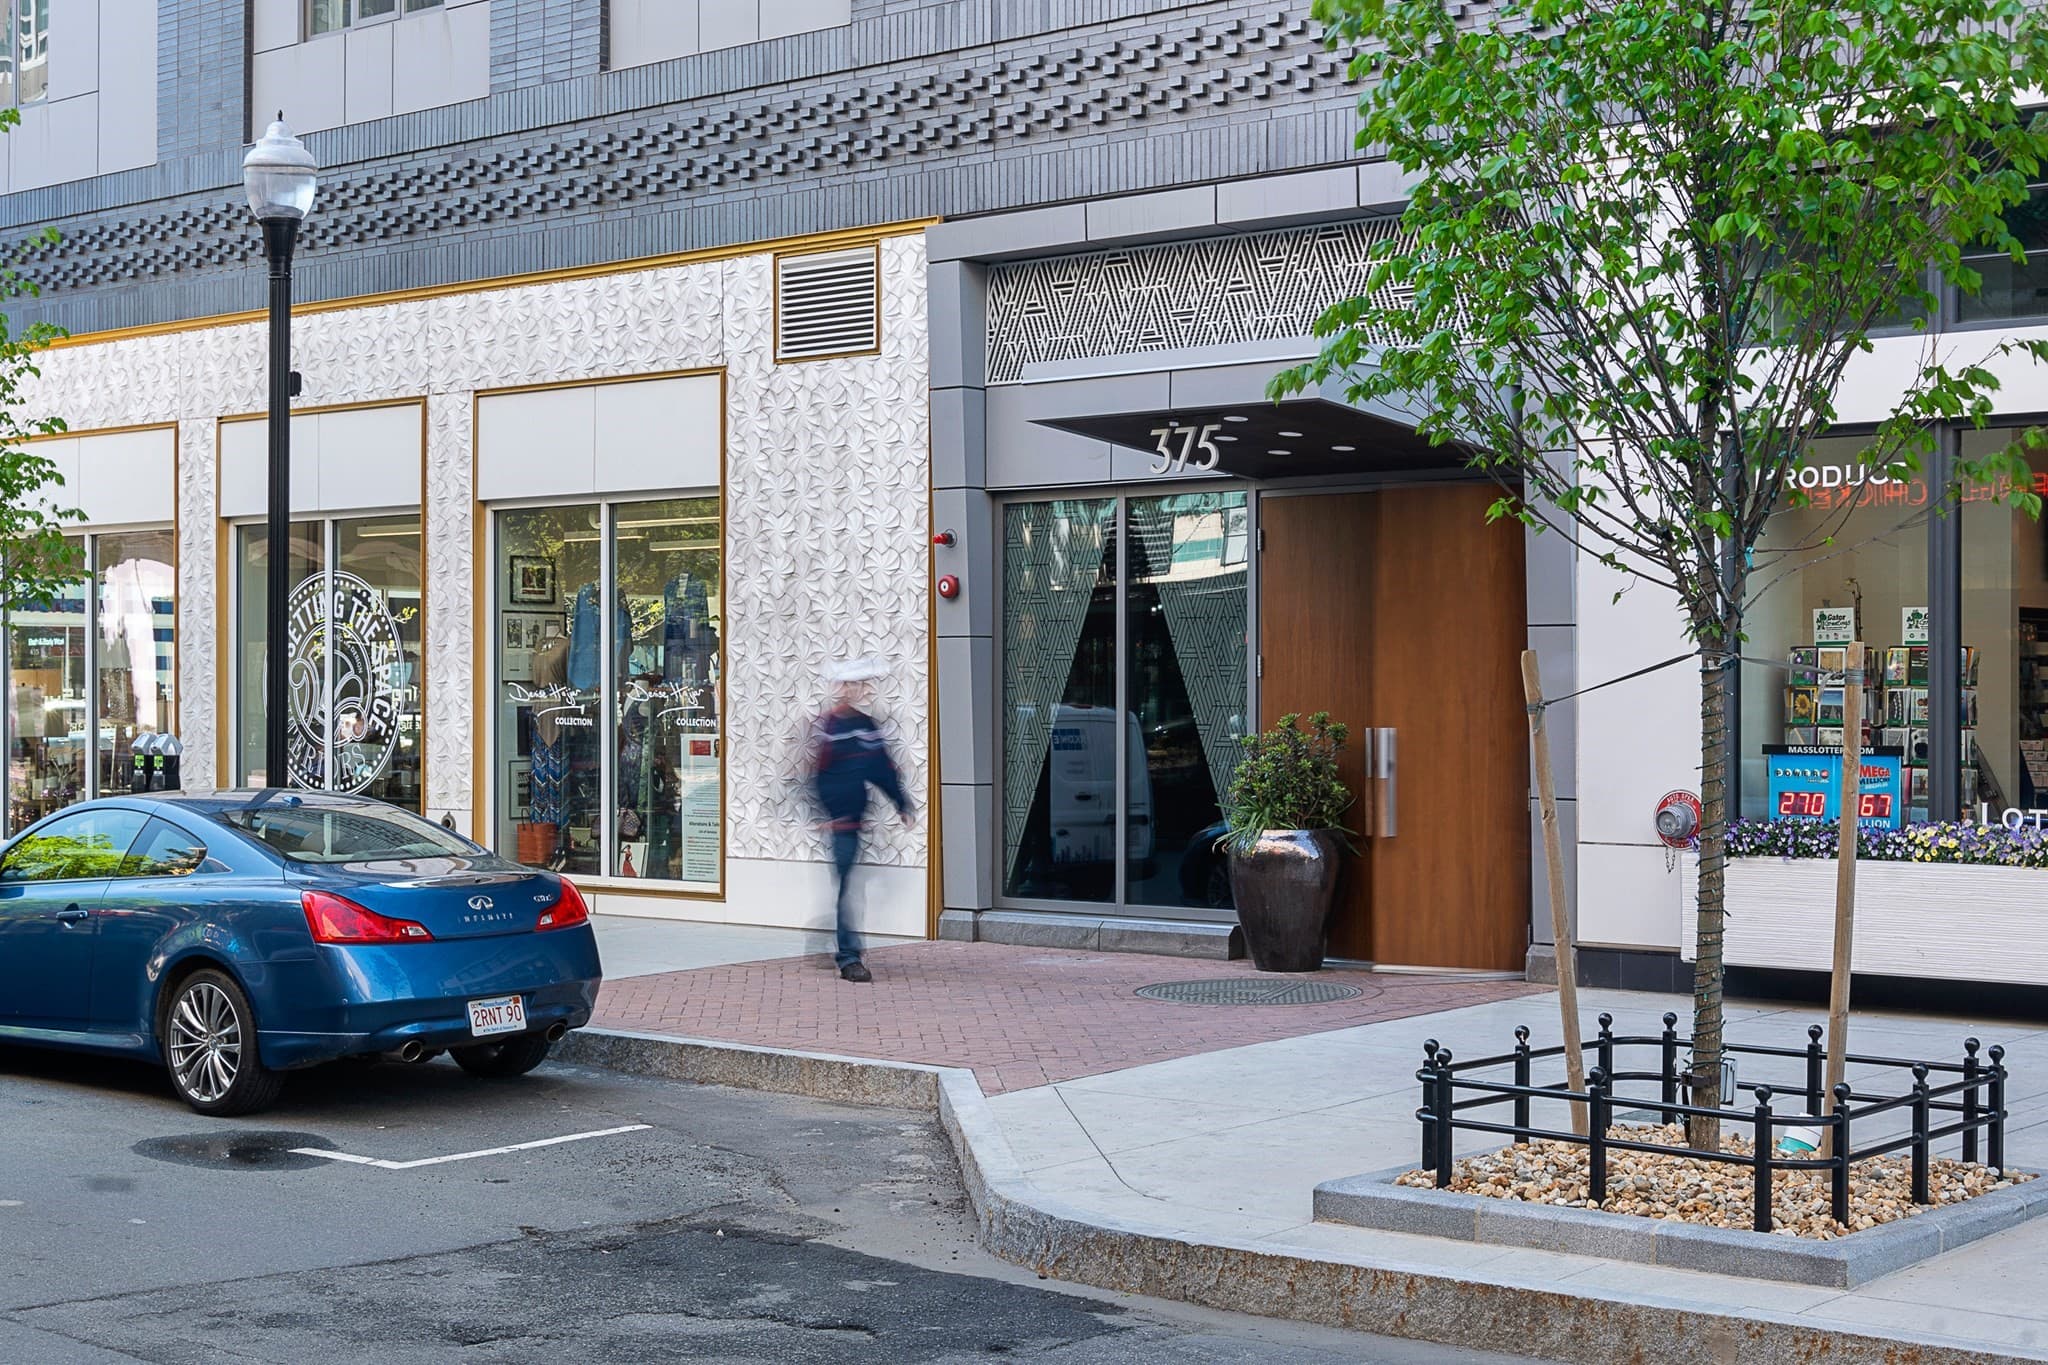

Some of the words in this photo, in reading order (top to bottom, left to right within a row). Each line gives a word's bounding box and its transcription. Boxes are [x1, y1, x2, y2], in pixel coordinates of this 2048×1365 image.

[1150, 424, 1221, 474] 375
[349, 596, 381, 646] THE
[371, 641, 393, 737] SPACE
[555, 717, 593, 726] COLLECTION
[676, 718, 717, 727] COLLECTION
[1859, 765, 1890, 777] MEGA
[1780, 793, 1825, 815] 270
[473, 1006, 503, 1027] 2RNT
[506, 1004, 522, 1023] 90
